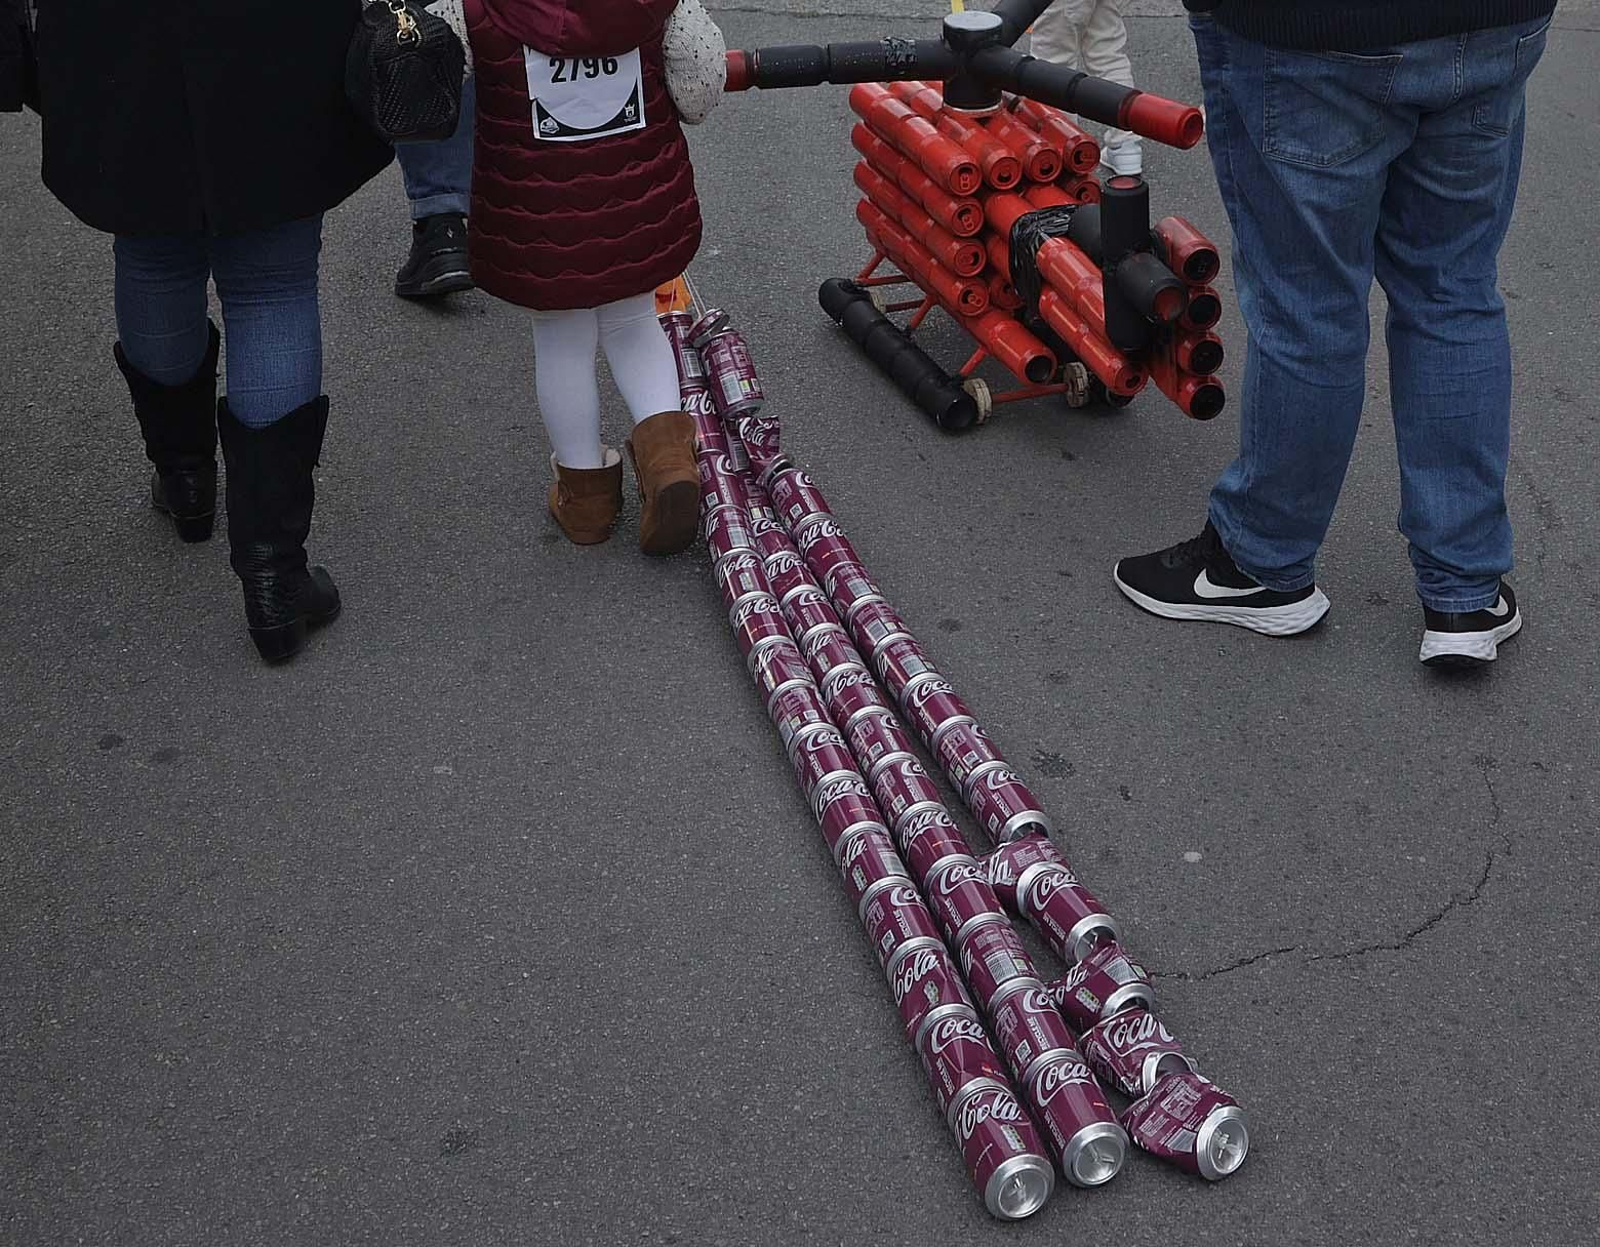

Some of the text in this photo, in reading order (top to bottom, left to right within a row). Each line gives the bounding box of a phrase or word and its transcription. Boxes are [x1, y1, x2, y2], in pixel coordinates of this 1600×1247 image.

[1032, 872, 1079, 911] Coca
[931, 1018, 986, 1054] Coca
[1037, 1062, 1091, 1107] Coca
[961, 1092, 1022, 1140] Cola
